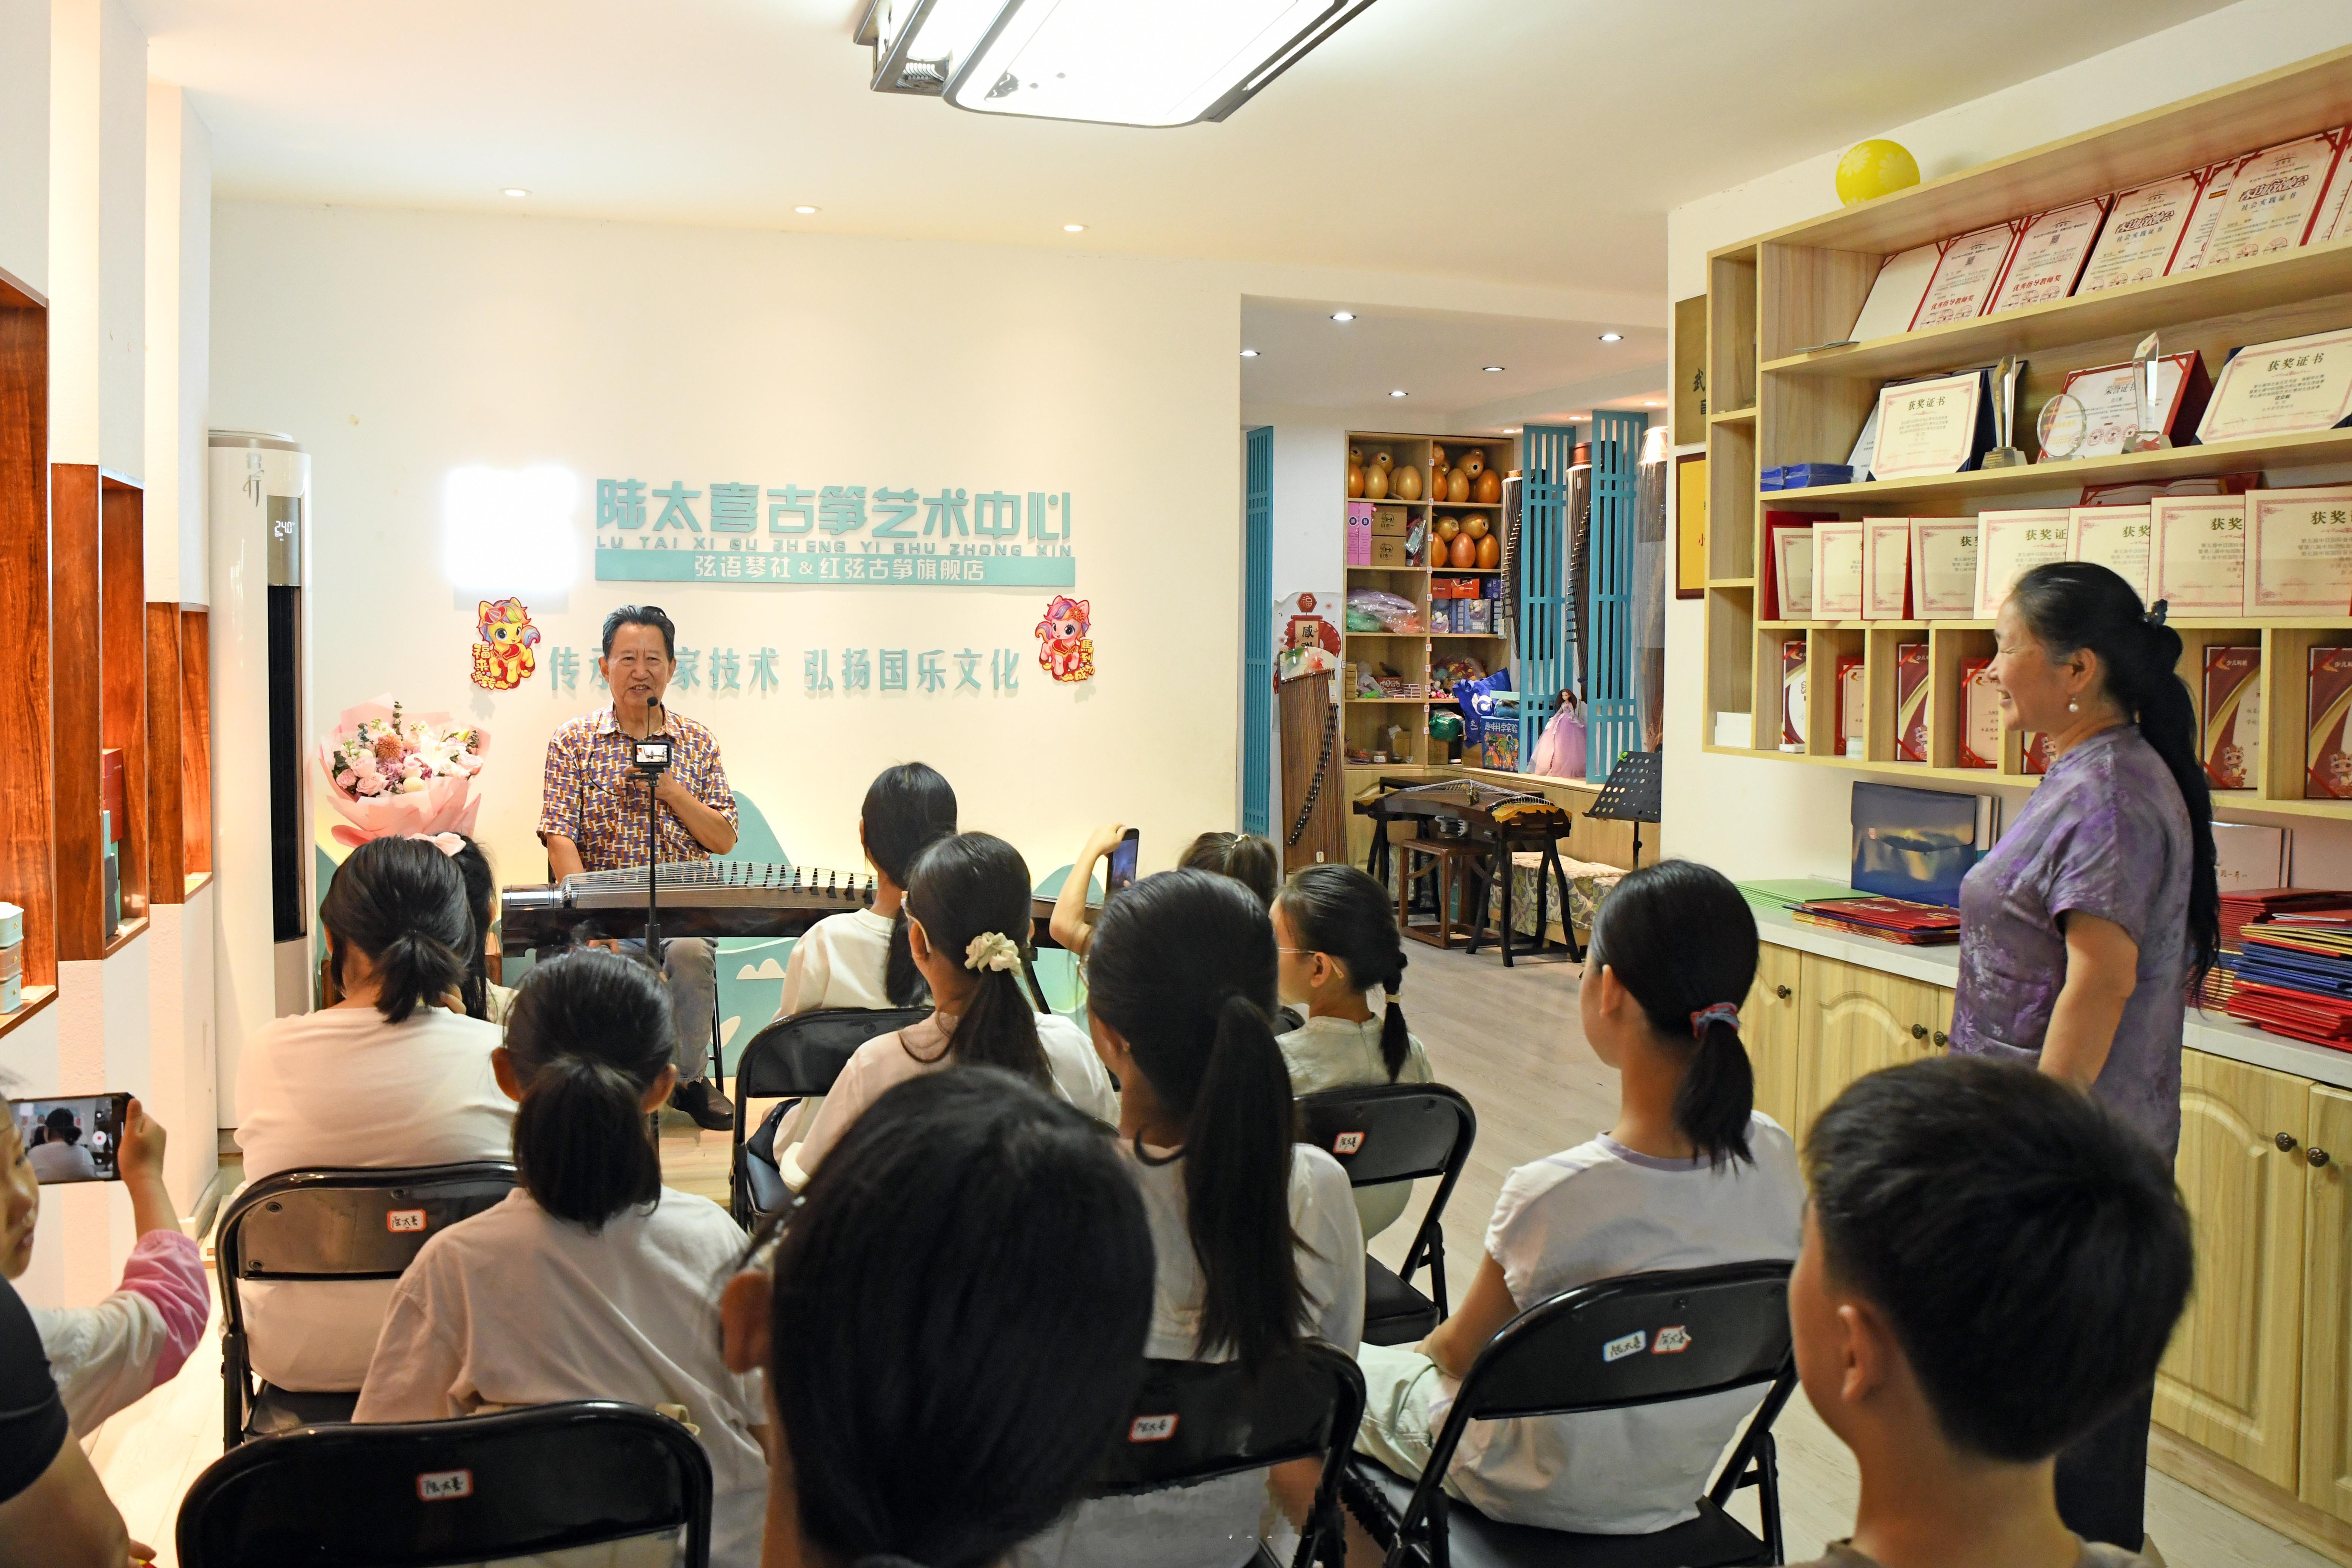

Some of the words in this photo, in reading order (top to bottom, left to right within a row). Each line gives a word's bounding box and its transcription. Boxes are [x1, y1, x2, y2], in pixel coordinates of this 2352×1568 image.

[2013, 275, 2062, 292] 优秀指导教师奖
[1931, 294, 1975, 310] 优秀指导教师奖
[2267, 353, 2324, 371] 获奖证书
[1908, 396, 1946, 411] 获奖证书
[597, 478, 1070, 540] 陆太喜古筝艺术中心
[597, 536, 623, 548] LU
[640, 536, 678, 548] TAI
[694, 537, 714, 549] XI
[730, 538, 758, 550] GU
[860, 541, 880, 553] YI
[893, 542, 936, 554] SHU
[950, 543, 1022, 556] ZHONG
[1036, 544, 1071, 557] XIN
[694, 555, 791, 578] 弦语琴社
[820, 556, 984, 581] 红弦古筝旗舰店
[548, 646, 780, 691] 传家技术
[804, 648, 1020, 693] 弘扬国乐文化
